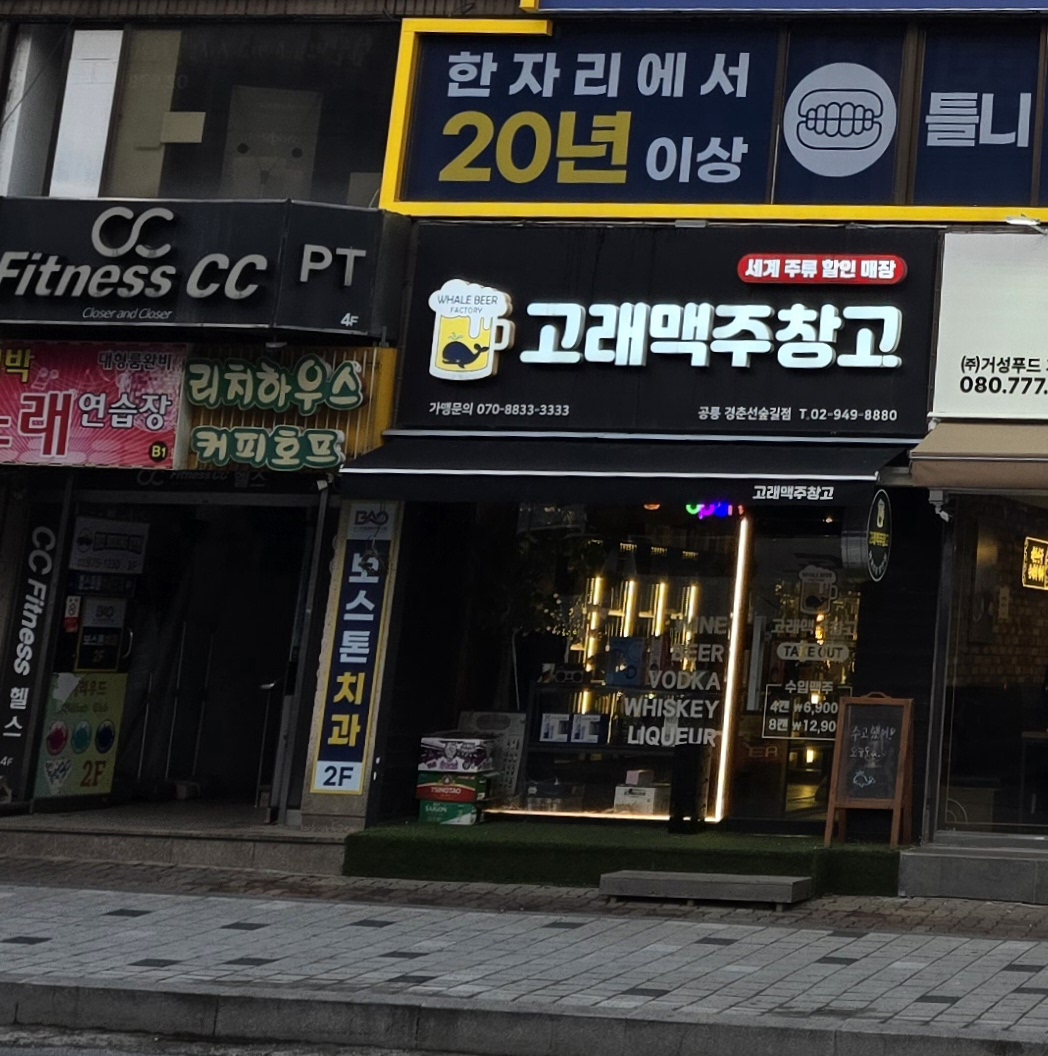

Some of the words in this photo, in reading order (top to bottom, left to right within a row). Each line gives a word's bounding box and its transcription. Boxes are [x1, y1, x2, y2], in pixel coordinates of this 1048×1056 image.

[925, 92, 1032, 147] 틀니
[438, 109, 632, 184] 20년
[645, 136, 749, 183] 이상
[0, 250, 177, 297] Fitness
[186, 253, 268, 300] CC
[300, 244, 367, 287] PT
[745, 259, 781, 278] 세계
[784, 259, 818, 278] 주류
[822, 260, 857, 279] 할인
[860, 260, 896, 279] 매장
[438, 295, 472, 305] WHALE
[474, 295, 498, 305] BEER
[82, 307, 116, 319] Closer
[116, 308, 137, 319] and
[138, 308, 173, 319] Closer
[340, 313, 359, 327] 4F
[519, 301, 903, 369] 고래맥주창고
[98, 351, 173, 370] 대형룸완비
[189, 357, 363, 413] 리치하우스
[429, 402, 474, 416] 가맹문의
[477, 403, 570, 416] 070-8833-3333
[698, 406, 722, 421] 공릉
[724, 406, 792, 421] 경춘선숲길점
[152, 445, 167, 458] B1
[195, 428, 340, 467] 커피호프
[752, 485, 835, 500] 고래맥주창고
[28, 526, 56, 575] CC
[14, 577, 47, 676] Fitness
[771, 618, 858, 636] 고래맥창고
[671, 644, 725, 663] BEER
[783, 645, 815, 658] TAE
[650, 670, 721, 691] VODKA
[784, 680, 834, 694] 수입맥주
[3, 686, 29, 738] 헬스
[624, 697, 720, 719] WHISKEY
[627, 725, 717, 747] LIQUEUR
[80, 760, 107, 787] 2F
[322, 765, 354, 788] 2F
